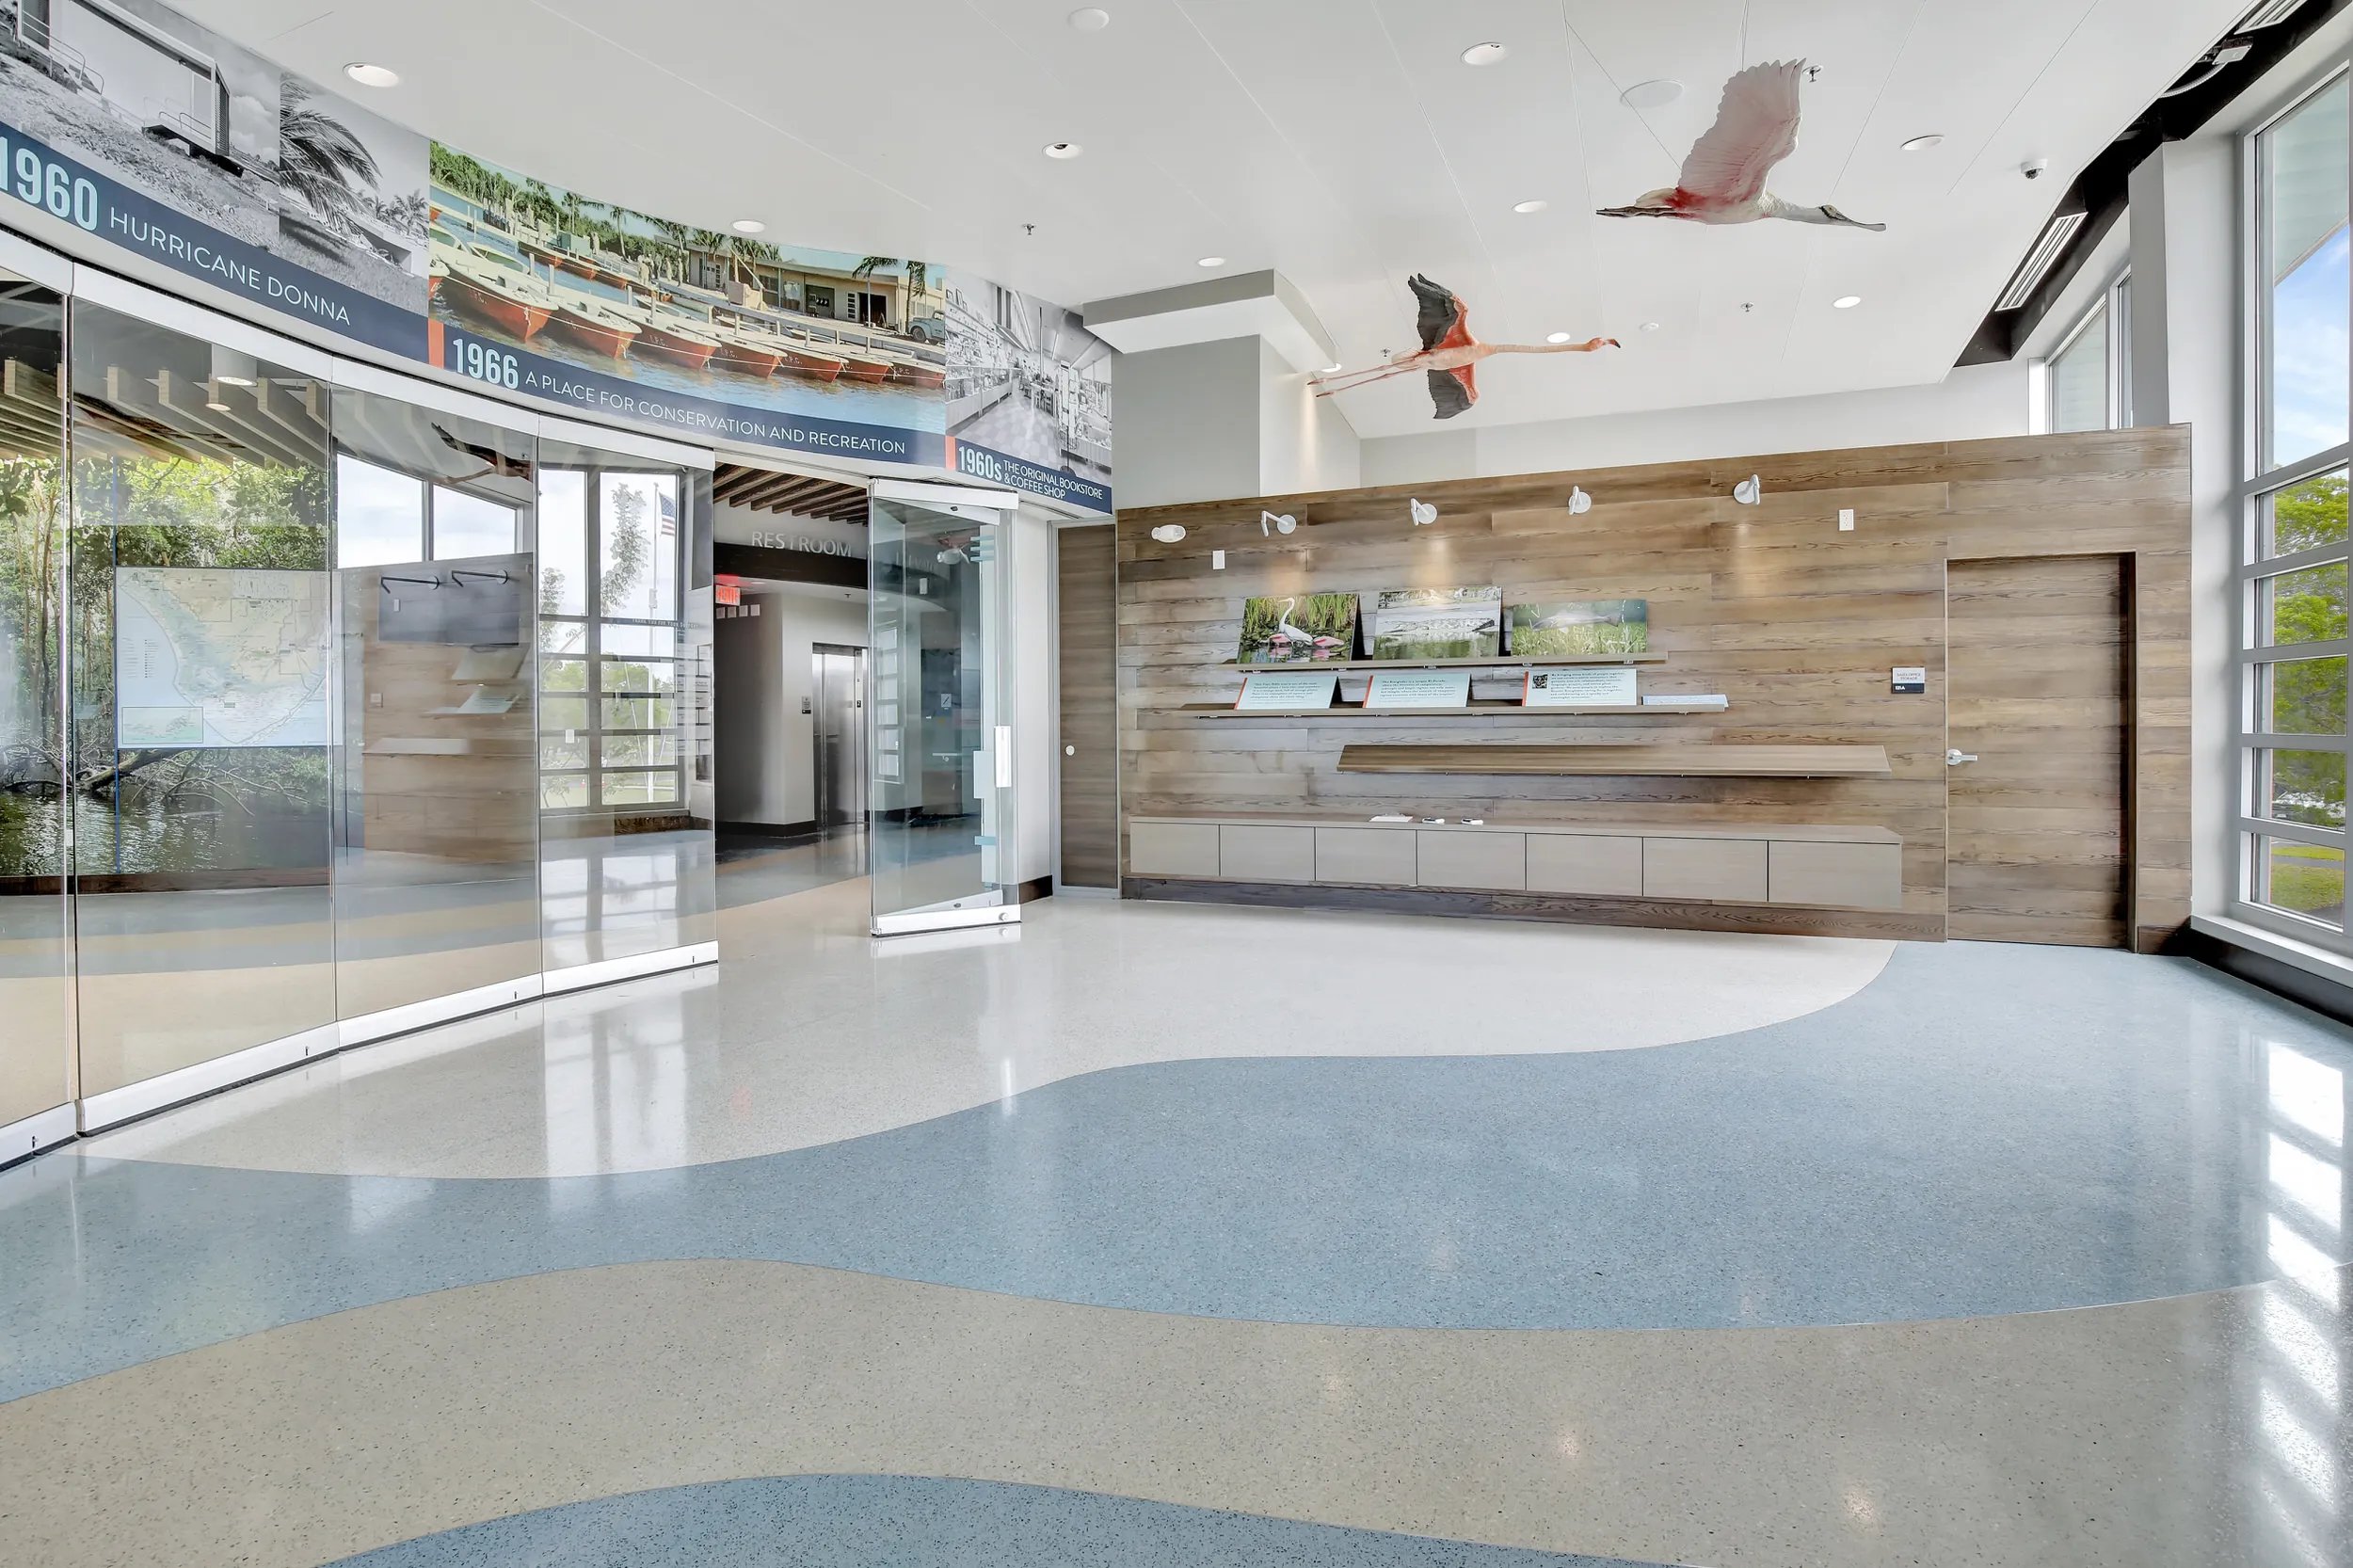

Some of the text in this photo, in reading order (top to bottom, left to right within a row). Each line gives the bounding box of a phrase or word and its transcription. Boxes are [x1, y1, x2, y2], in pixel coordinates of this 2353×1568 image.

[0, 136, 350, 326] 1960 HURRICANE DONNA
[452, 338, 905, 455] 1966 A PLACE FOR CONSERVATION AND RECREATION
[958, 446, 1103, 500] 1960s THE ORIGINAL BOOKSTORE
[1044, 484, 1065, 499] SHOP
[751, 531, 852, 557] RESTROOM
